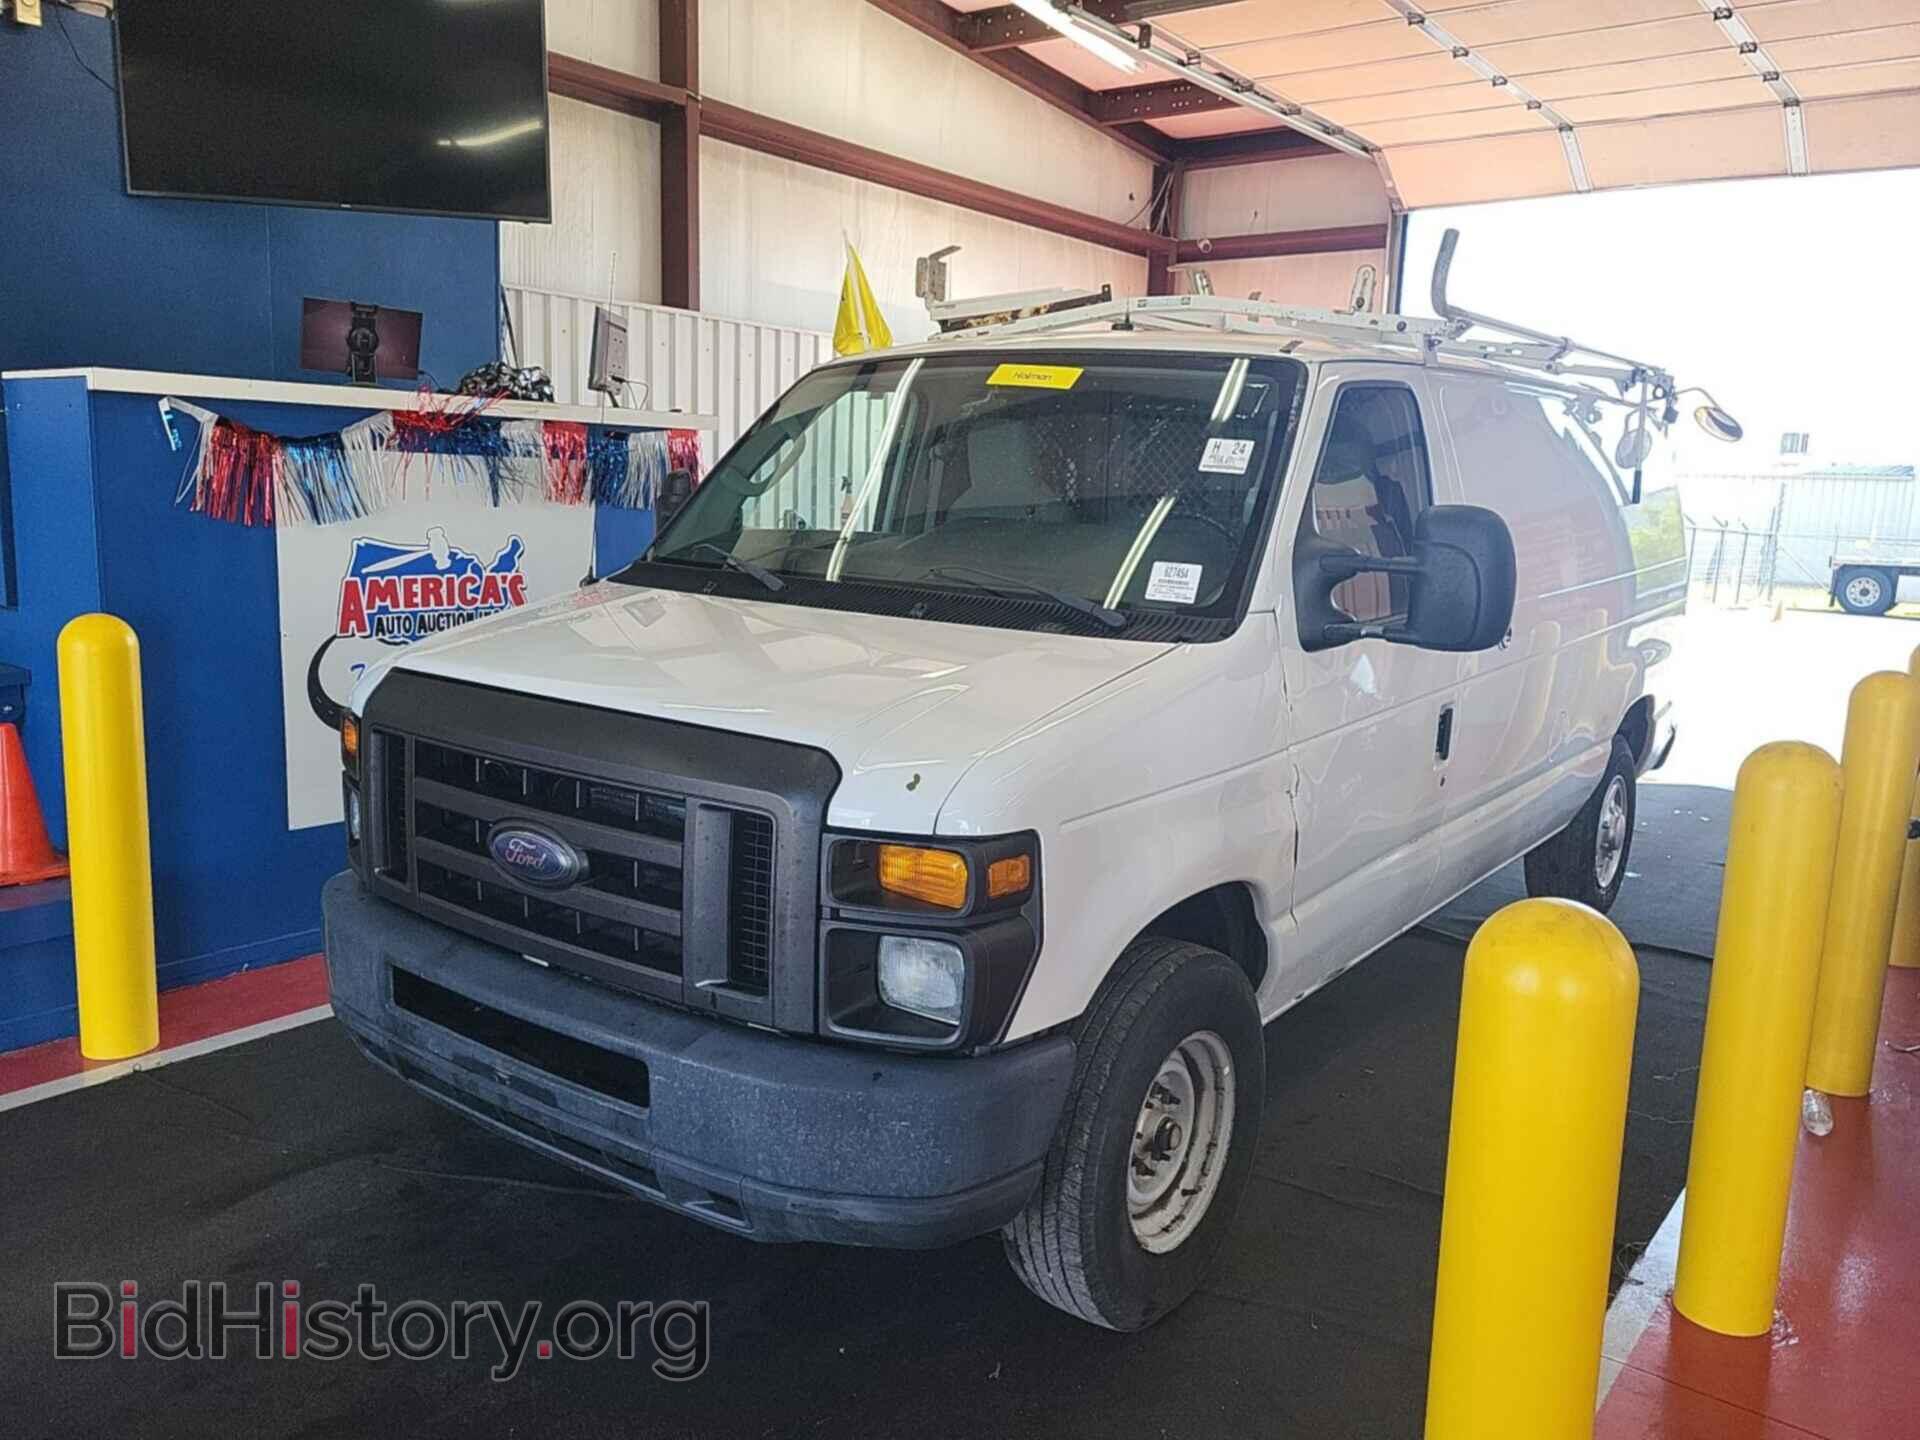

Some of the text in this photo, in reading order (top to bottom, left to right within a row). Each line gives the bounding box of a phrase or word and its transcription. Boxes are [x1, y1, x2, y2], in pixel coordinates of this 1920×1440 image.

[1231, 442, 1247, 455] 24
[338, 573, 528, 634] AMERICA'S
[375, 615, 412, 637] AUTO
[505, 838, 547, 868] Ford
